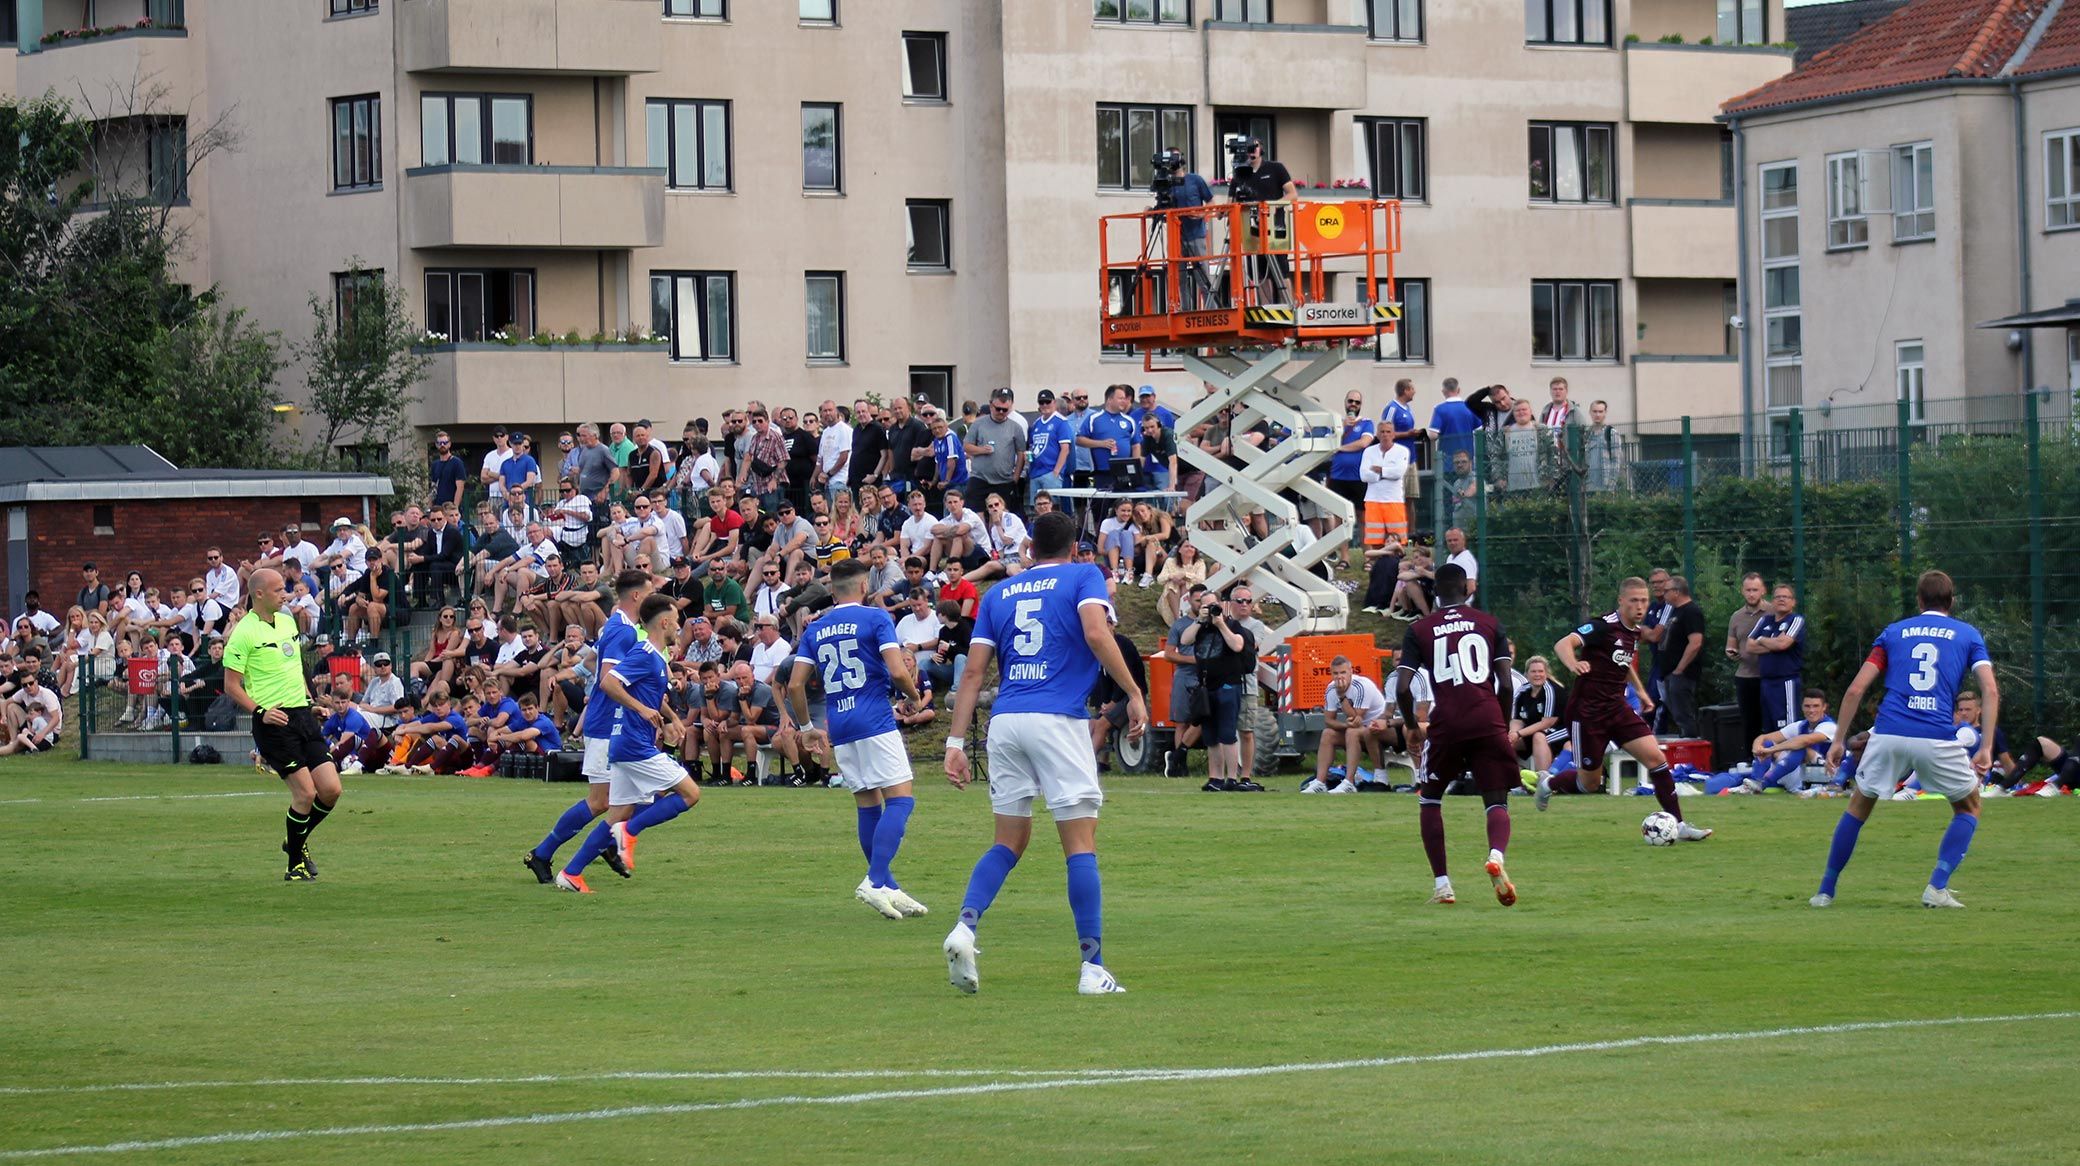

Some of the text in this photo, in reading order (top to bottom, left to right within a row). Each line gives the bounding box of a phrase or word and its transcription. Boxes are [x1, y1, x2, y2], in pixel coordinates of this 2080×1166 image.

[1319, 217, 1339, 226] DRA
[1185, 315, 1229, 328] STEINESS
[1316, 308, 1358, 319] snorkel
[1115, 322, 1141, 333] snorkel
[1002, 578, 1058, 599] AMAGER
[816, 623, 857, 642] AMAGER
[1013, 598, 1043, 656] 5
[1433, 621, 1475, 636] DARAMY
[1902, 626, 1956, 640] AMAGER
[817, 638, 867, 694] 25
[1433, 633, 1489, 687] 40
[1909, 642, 1938, 691] 3
[1009, 661, 1048, 680] CAVNIĆ
[1907, 695, 1937, 711] GABEL
